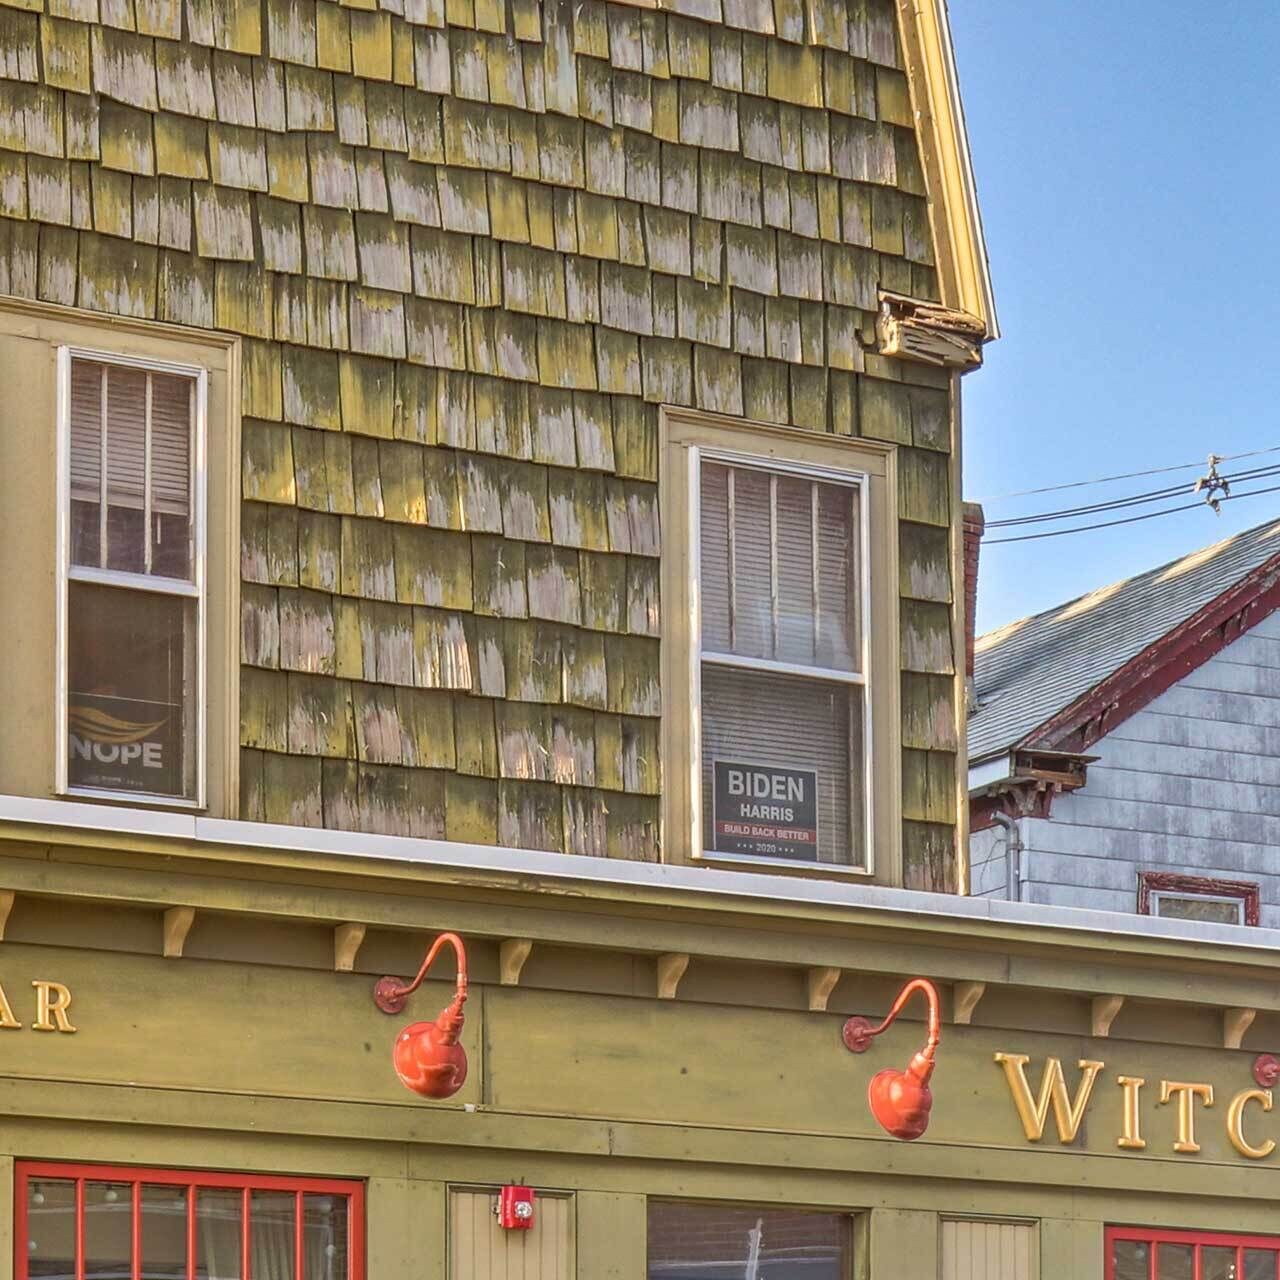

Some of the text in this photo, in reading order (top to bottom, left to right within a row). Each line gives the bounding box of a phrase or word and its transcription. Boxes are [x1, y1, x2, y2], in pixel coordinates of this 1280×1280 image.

[69, 733, 163, 768] NOPE
[728, 770, 804, 802] BIDEN
[740, 803, 794, 822] HARRIS
[724, 824, 810, 841] BUILD BACK BETTER
[756, 843, 777, 853] 2020
